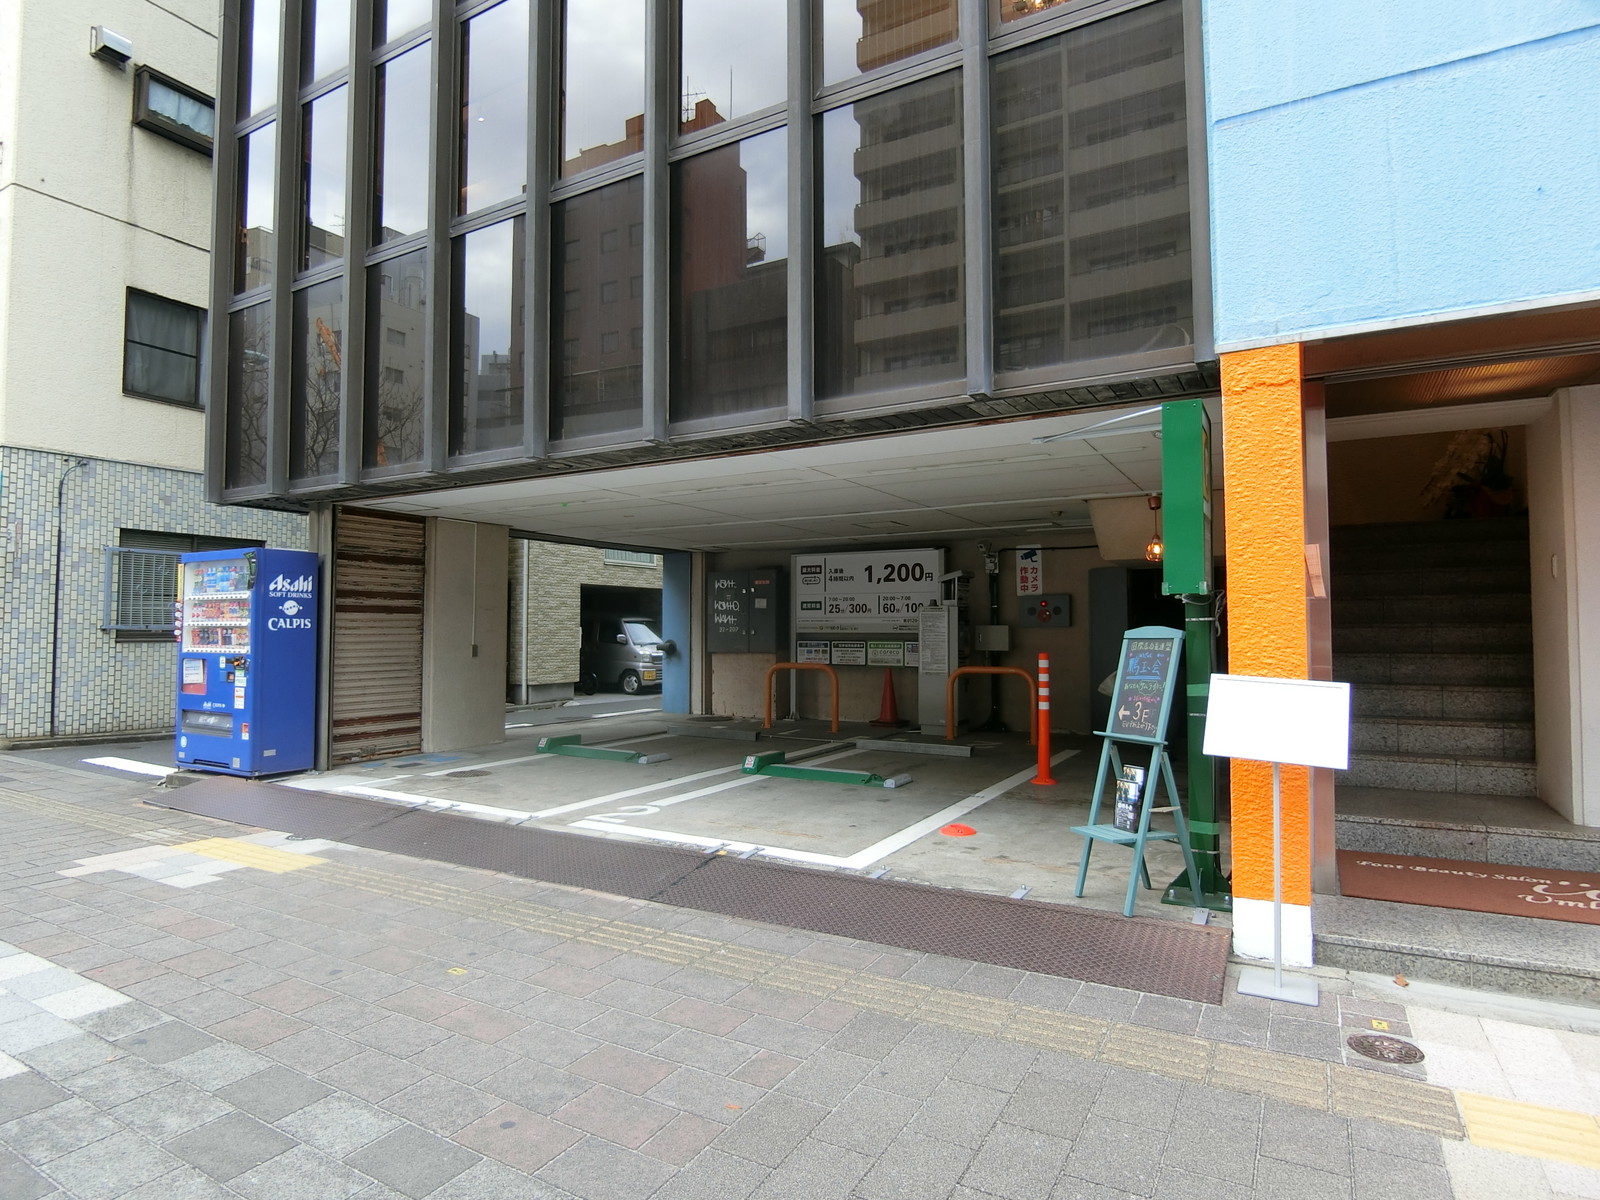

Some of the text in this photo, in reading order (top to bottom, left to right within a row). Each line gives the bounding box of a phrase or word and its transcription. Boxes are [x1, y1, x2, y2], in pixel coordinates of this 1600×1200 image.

[269, 574, 313, 592] Asahi
[864, 562, 934, 585] 1,200円
[1020, 566, 1028, 592] 作動中
[1030, 566, 1038, 592] カメラ
[287, 591, 313, 599] DRINKS
[268, 617, 312, 631] CALPIS
[1132, 701, 1150, 722] 3F
[583, 805, 660, 823] 2
[1356, 859, 1552, 885] Foot Beauty Salon
